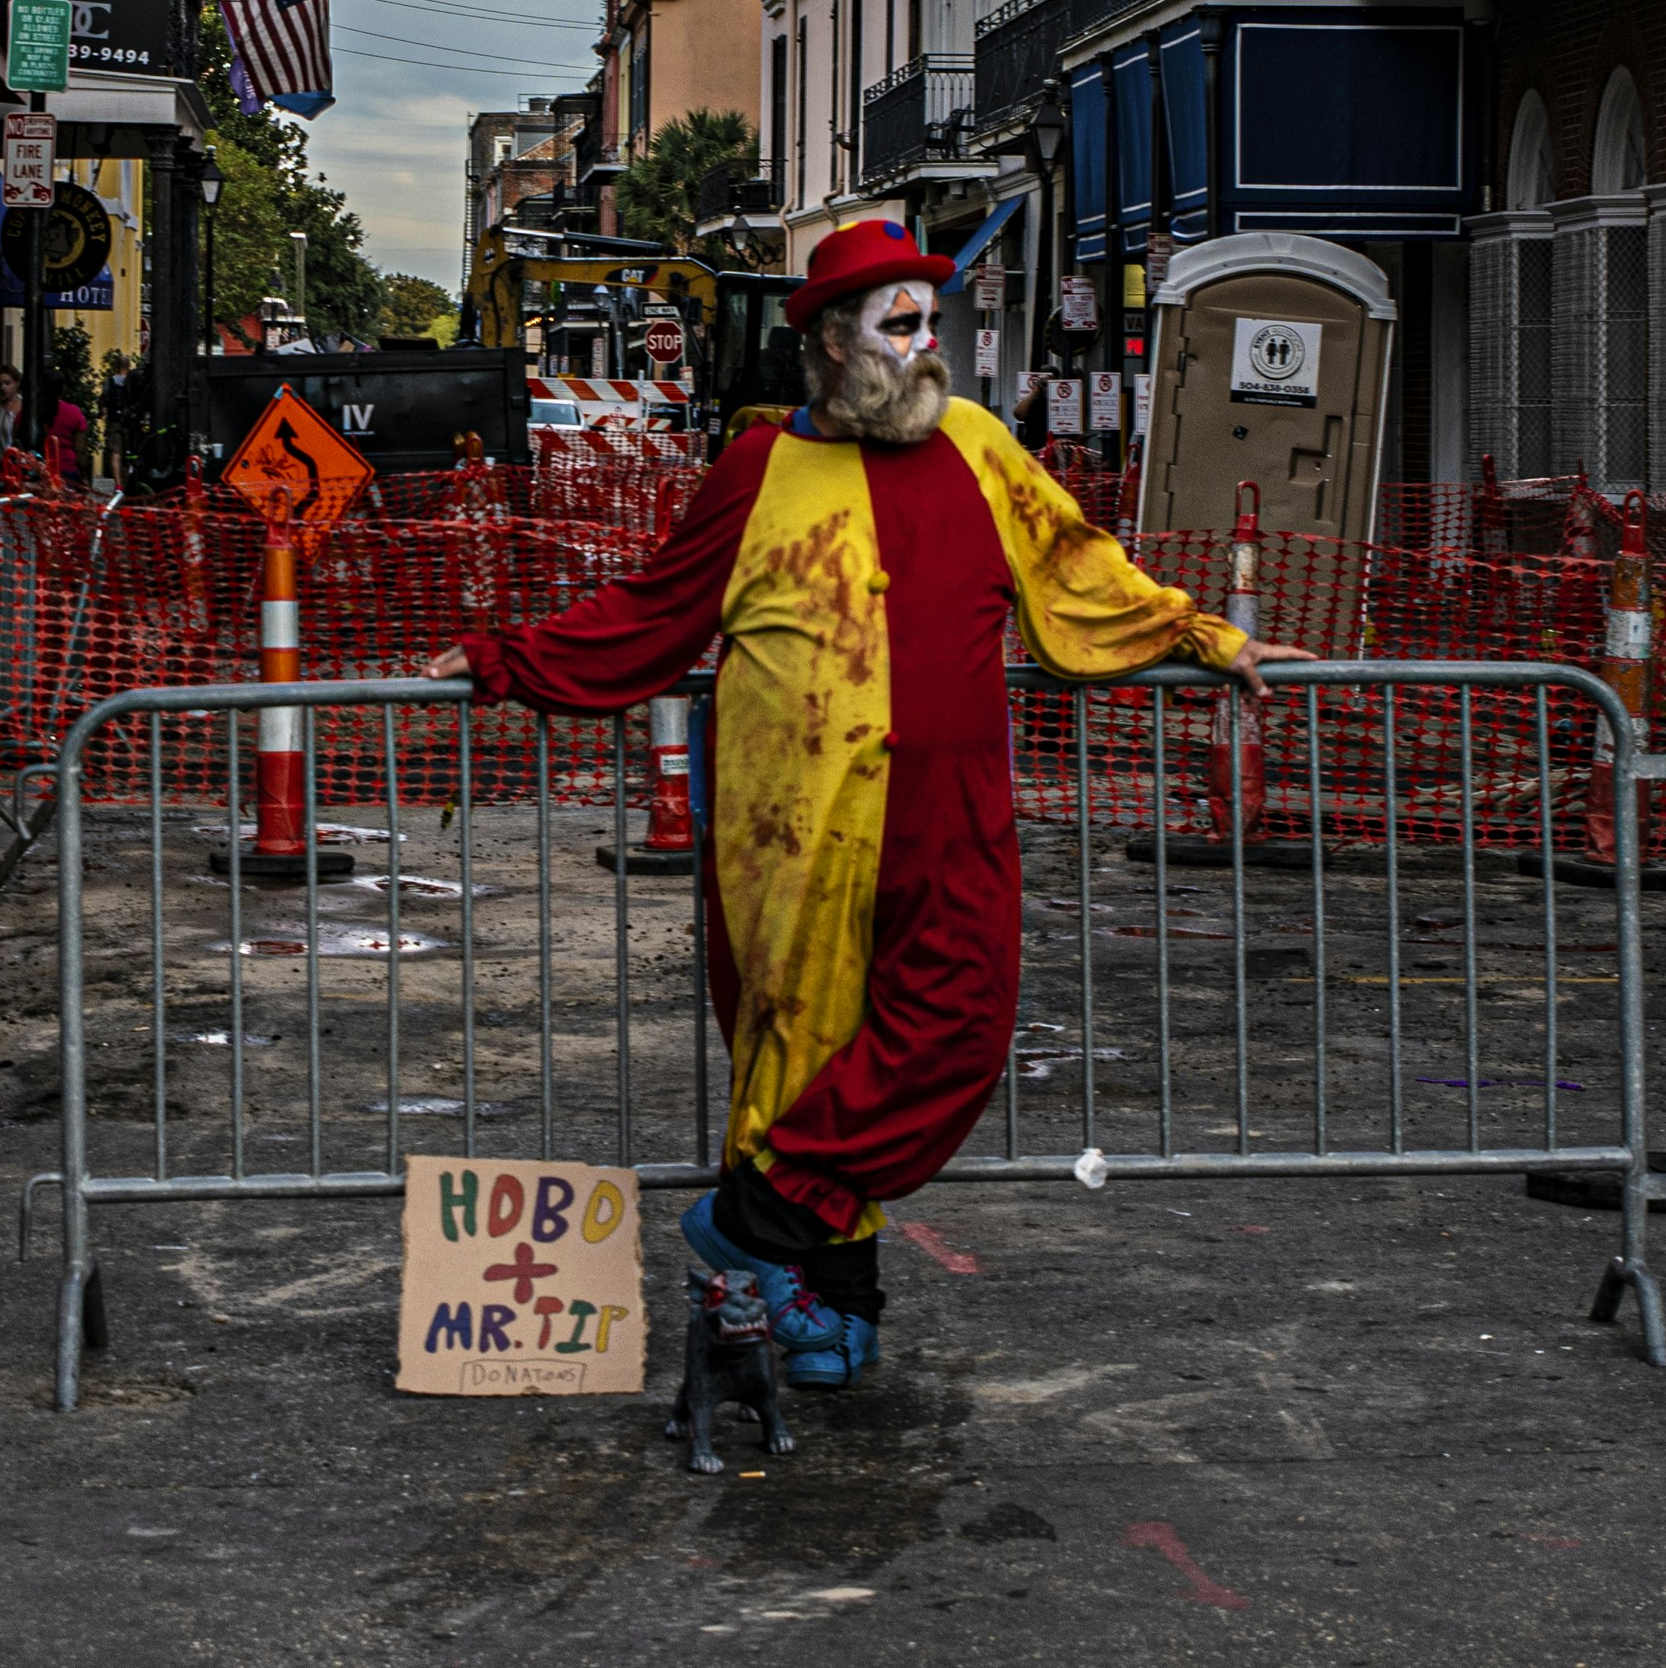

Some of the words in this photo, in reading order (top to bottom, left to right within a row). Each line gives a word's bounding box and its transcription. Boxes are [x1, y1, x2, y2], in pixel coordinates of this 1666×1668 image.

[68, 44, 150, 65] 39-9494
[8, 118, 23, 135] NO
[16, 144, 42, 159] FIRE
[13, 164, 44, 179] LANE
[60, 189, 107, 243] MONKEY
[45, 268, 89, 287] RILL
[621, 268, 645, 283] CAT
[648, 335, 682, 350] STOP
[343, 404, 374, 430] IV
[440, 1169, 625, 1243] HOBO
[424, 1301, 524, 1354] MR.
[533, 1296, 630, 1354] TIP
